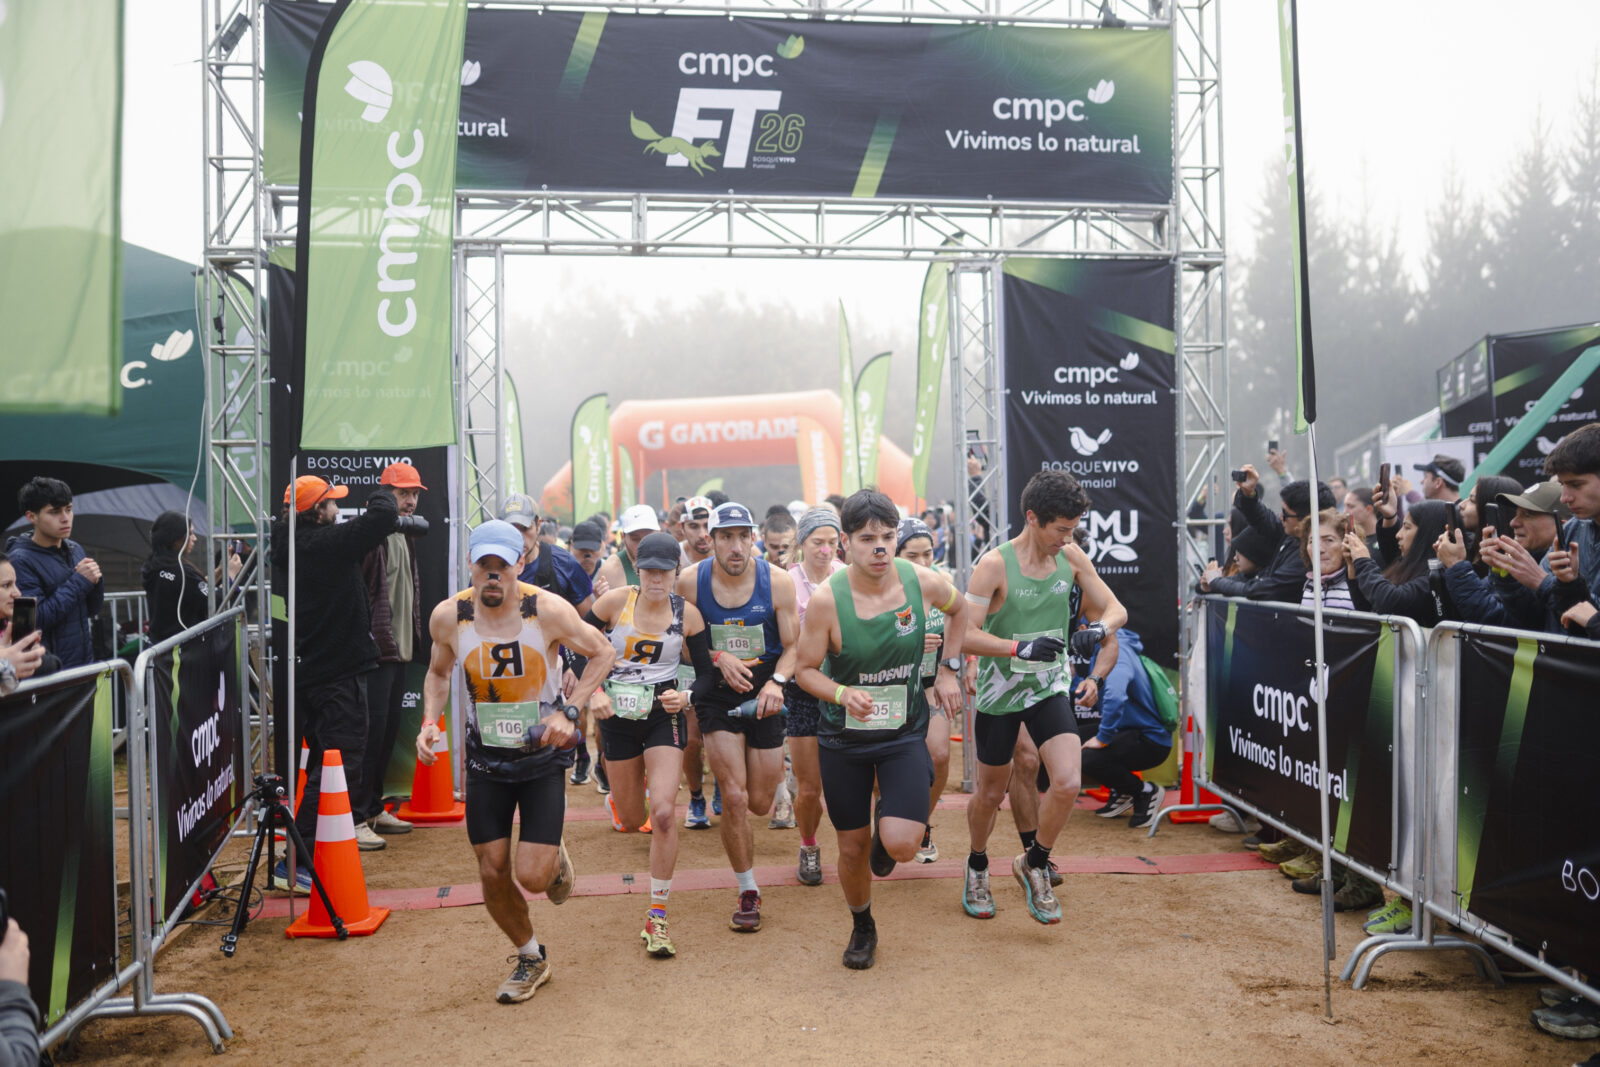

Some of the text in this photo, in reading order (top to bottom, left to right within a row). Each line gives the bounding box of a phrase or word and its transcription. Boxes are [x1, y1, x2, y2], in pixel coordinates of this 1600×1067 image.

[678, 52, 774, 83] cmpc
[993, 97, 1085, 127] cmpc
[665, 87, 806, 169] FT 26
[945, 130, 1141, 153] Vivimos lo natural
[377, 128, 431, 337] cmpc
[1054, 366, 1119, 388] cmpc
[1021, 390, 1158, 405] Vivimos lo natural
[638, 416, 799, 450] G GATORADE
[1041, 460, 1139, 476] BOSQUEVIVO
[728, 638, 749, 649] 108
[859, 663, 915, 684] PHOENIX
[616, 695, 637, 709] 118
[1252, 683, 1309, 737] cmpc
[191, 711, 220, 769] cmpc
[498, 721, 522, 734] 106
[1229, 725, 1349, 802] Vivimos lo natral
[207, 780, 214, 810] lo
